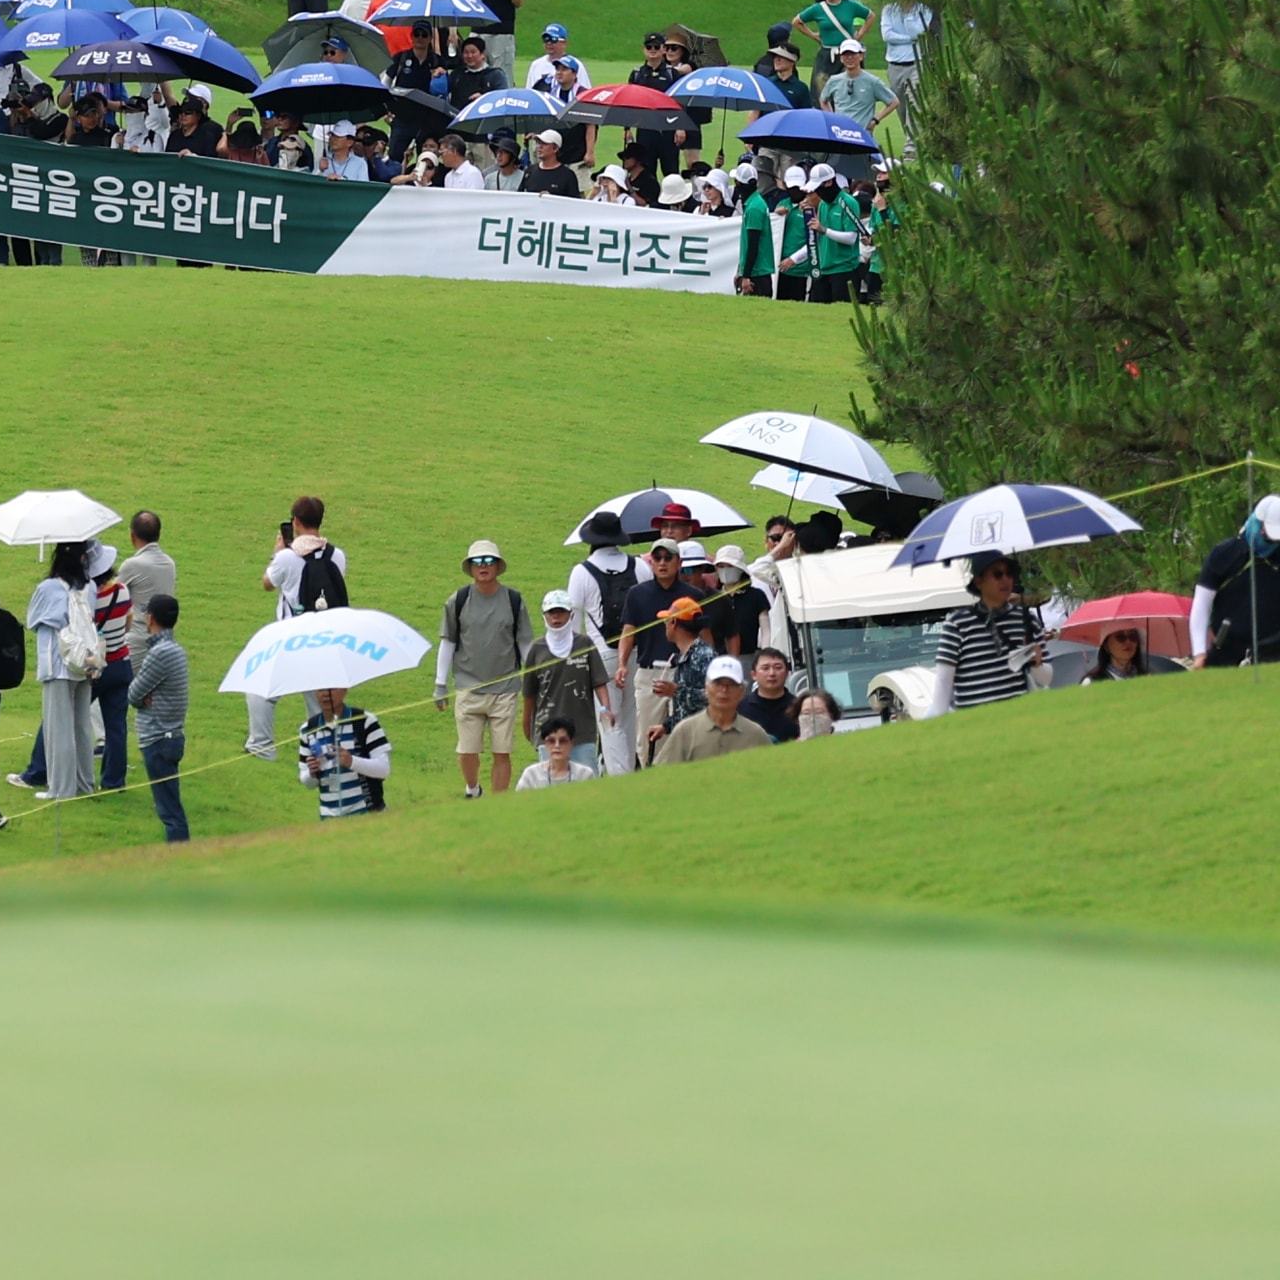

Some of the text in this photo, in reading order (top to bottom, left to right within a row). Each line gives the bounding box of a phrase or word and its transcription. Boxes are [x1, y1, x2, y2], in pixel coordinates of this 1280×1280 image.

[91, 176, 288, 244] 응원합니다
[478, 217, 711, 277] 더헤븐리조트
[244, 630, 390, 680] DOOSAN
